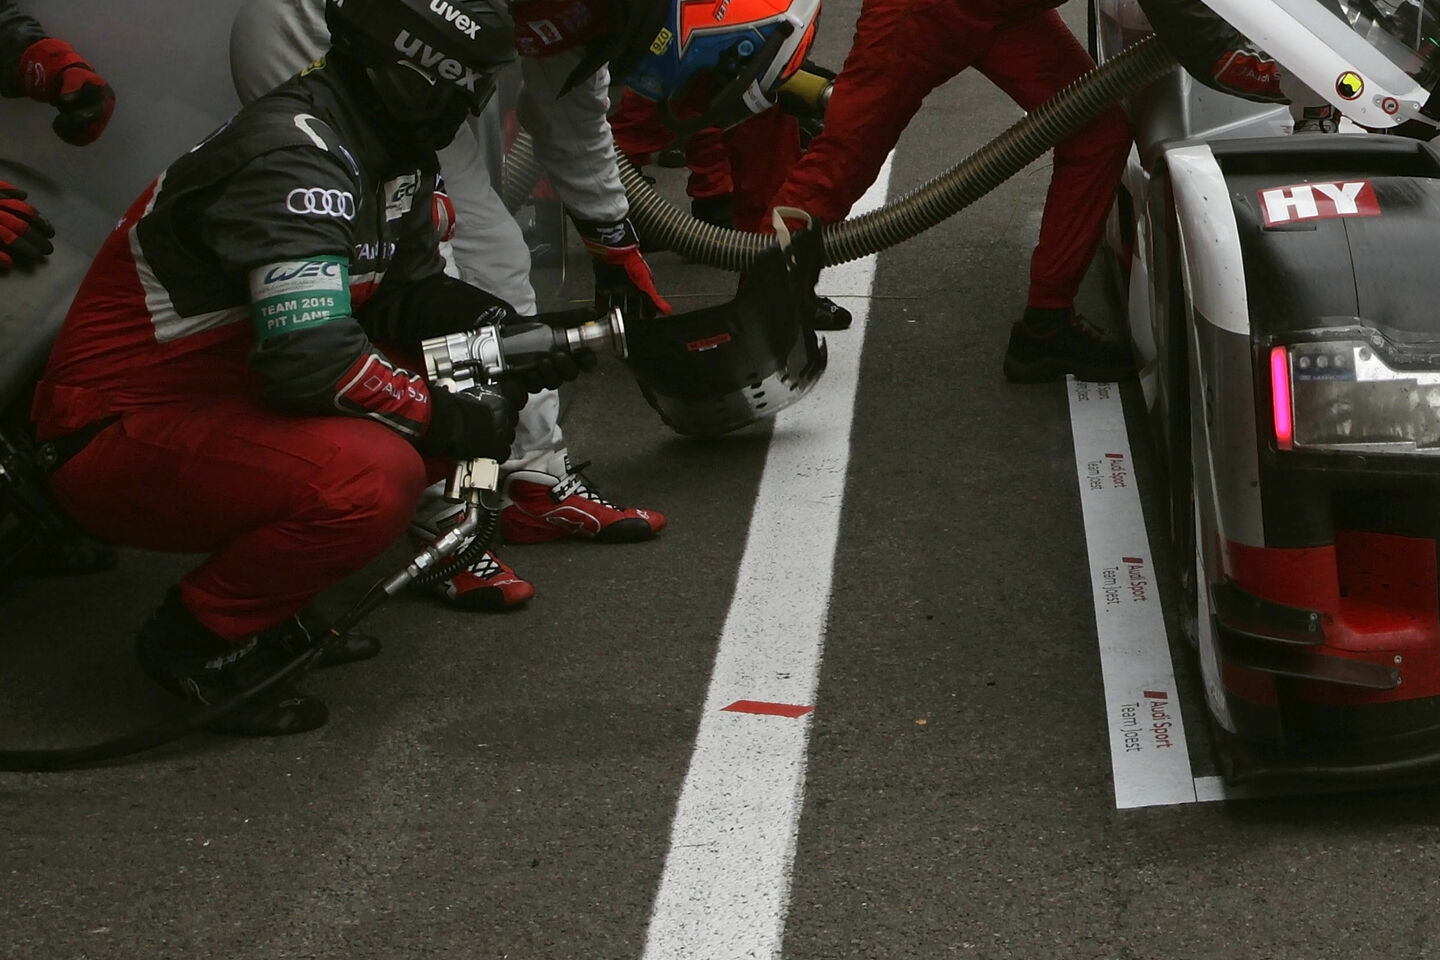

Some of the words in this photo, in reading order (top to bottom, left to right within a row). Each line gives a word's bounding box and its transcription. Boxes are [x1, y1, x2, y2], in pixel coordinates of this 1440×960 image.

[394, 29, 483, 93] uvex
[1263, 182, 1365, 223] HY
[264, 261, 339, 284] WEC
[261, 300, 297, 316] TEAM
[302, 297, 334, 308] 2015
[267, 316, 287, 329] PIT
[293, 310, 330, 324] LANE
[1103, 566, 1118, 585] Team
[1128, 565, 1144, 580] Audi
[1102, 585, 1122, 604] Joest
[1128, 581, 1147, 602] Sport
[1121, 702, 1139, 727] Team
[1151, 701, 1170, 722] Audi
[1120, 727, 1143, 752] Joest
[1150, 722, 1173, 749] Sport
